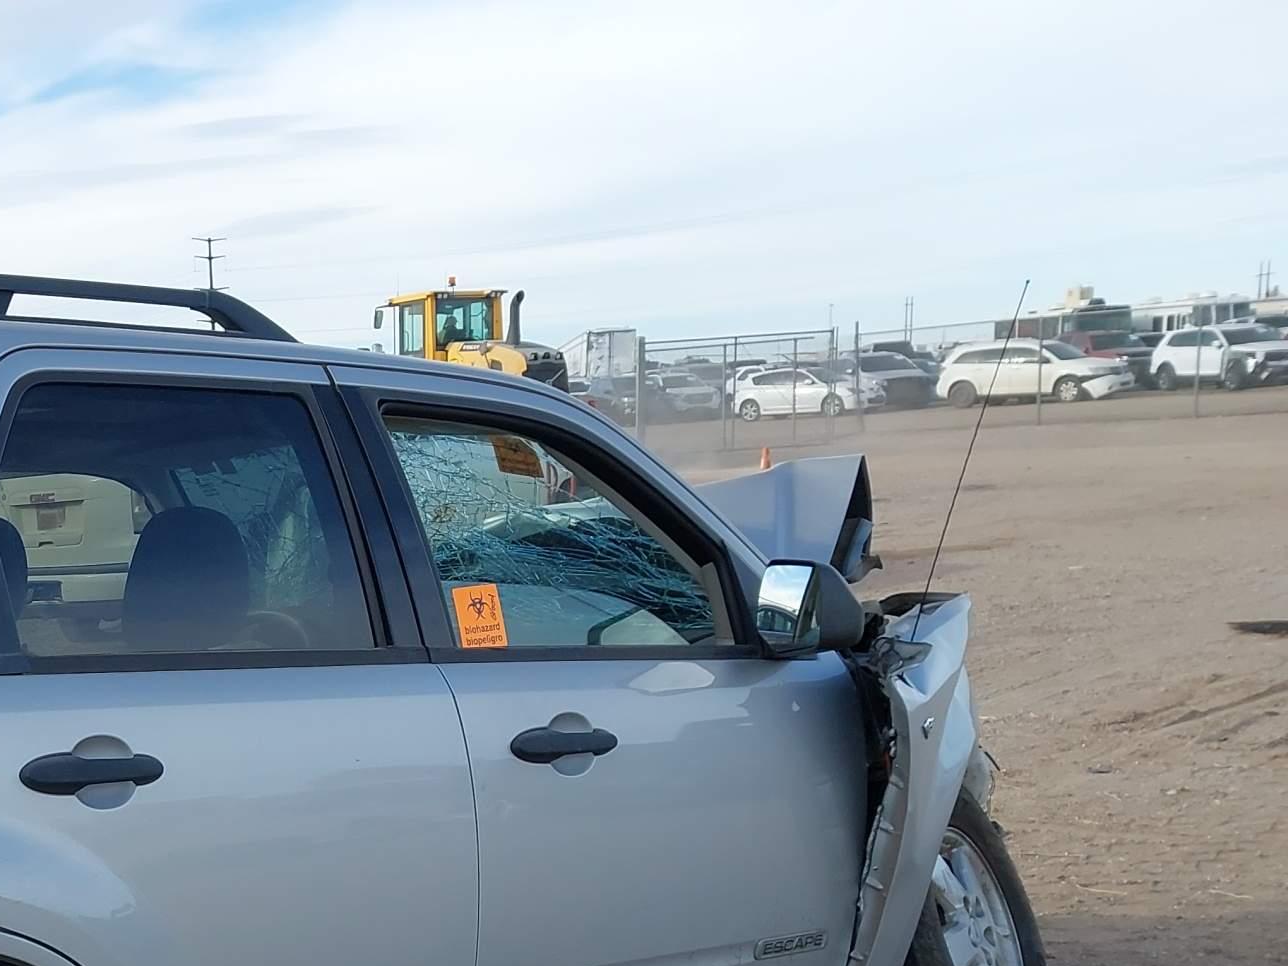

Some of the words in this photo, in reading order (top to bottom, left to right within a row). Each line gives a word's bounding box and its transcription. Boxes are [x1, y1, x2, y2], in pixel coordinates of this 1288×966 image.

[464, 622, 501, 634] biohazard
[466, 634, 503, 646] biopeligro
[762, 934, 824, 955] ESCAPE
